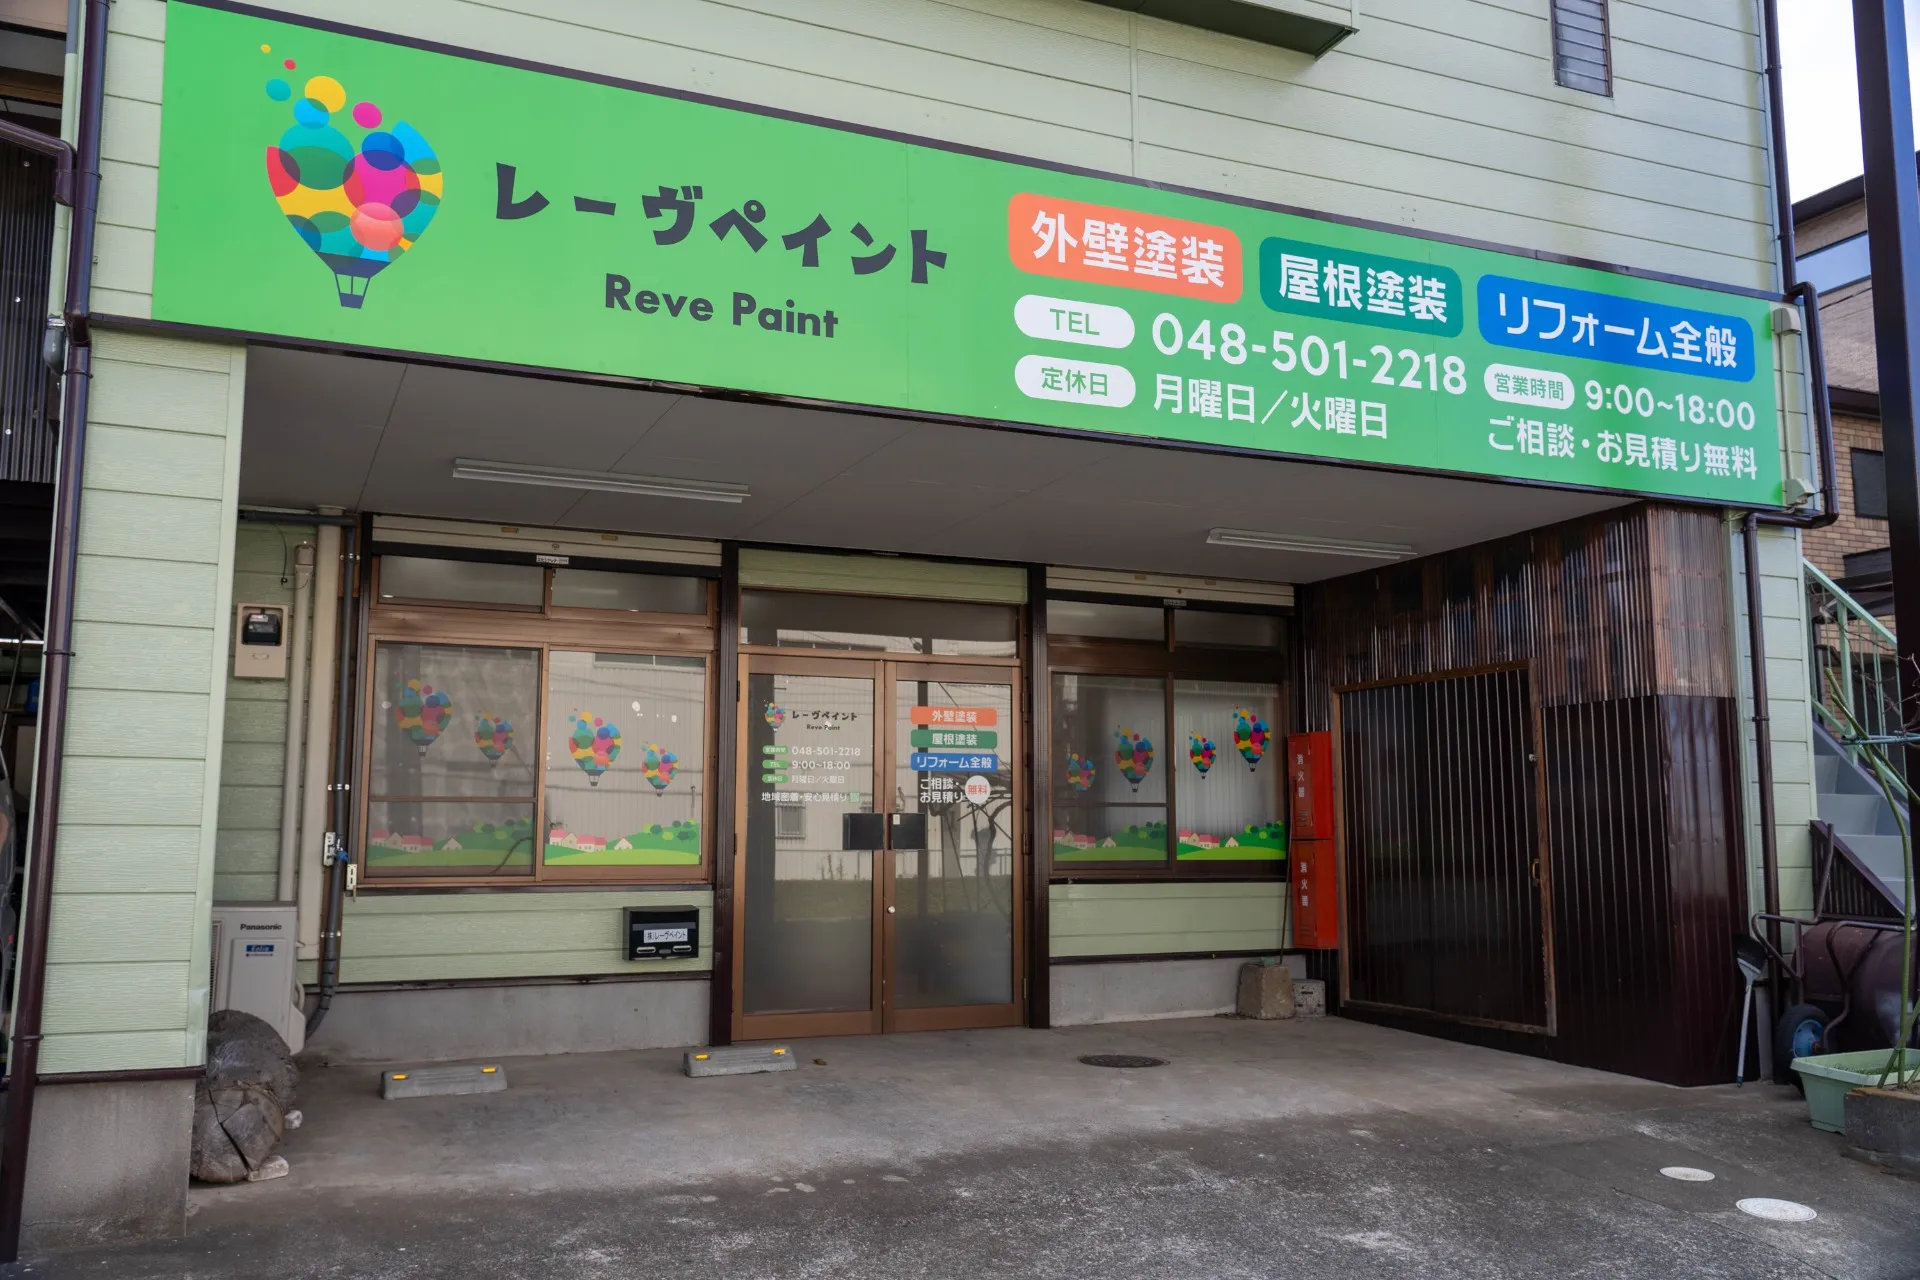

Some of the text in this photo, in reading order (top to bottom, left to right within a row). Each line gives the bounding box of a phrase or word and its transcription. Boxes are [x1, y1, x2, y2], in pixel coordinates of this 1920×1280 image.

[495, 161, 947, 285] レーヴペイント
[1030, 210, 1225, 289] 外壁塗装
[1278, 252, 1448, 324] 屋根塗装
[604, 272, 839, 339] Reve Paint
[1049, 307, 1100, 337] TEL
[1499, 292, 1738, 369] リフォーム全般
[1151, 311, 1468, 396] 048-501-2218
[1040, 365, 1109, 397] 定休日
[1493, 372, 1565, 401] 営業時間
[1488, 415, 1758, 481] ご相談・お見積り無料
[792, 709, 858, 721] レーヴペイント
[932, 710, 977, 723] 外壁塗装
[791, 746, 861, 757] 048-501-2218
[932, 733, 977, 746] 屋根塗装
[916, 756, 993, 769] リフォーム全般
[919, 791, 963, 804] お見積り
[967, 784, 987, 795] 無料
[240, 923, 283, 931] Panasonic
